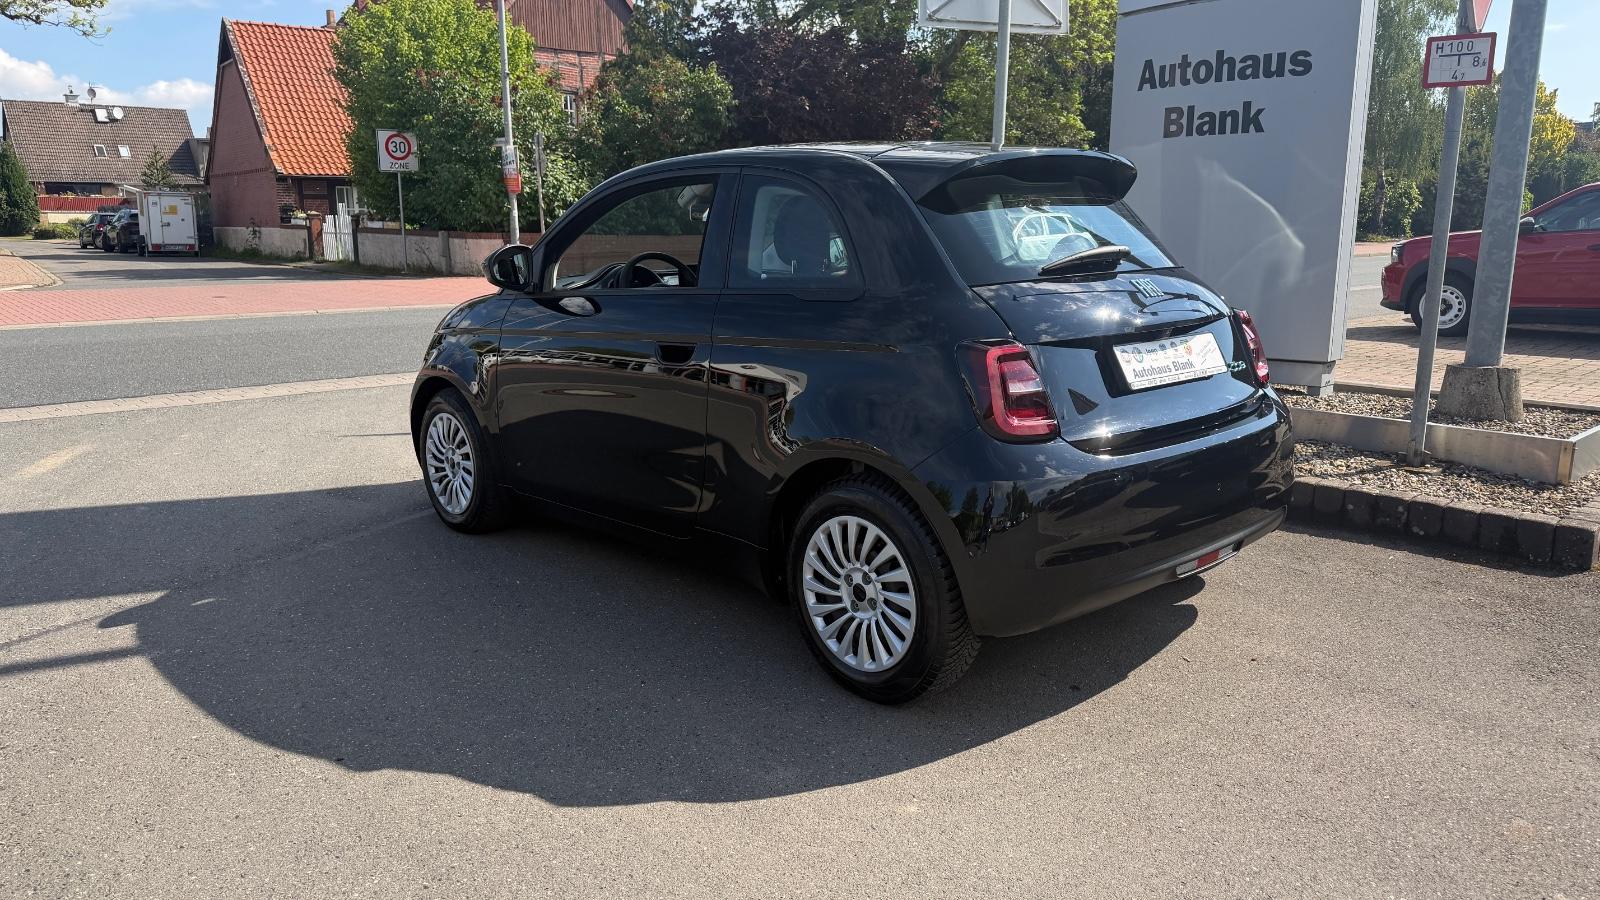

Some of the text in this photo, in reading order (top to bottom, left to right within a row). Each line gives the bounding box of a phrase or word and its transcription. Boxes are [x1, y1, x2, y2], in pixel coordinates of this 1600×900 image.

[1137, 50, 1313, 91] Autohaus
[1163, 101, 1266, 138] Blank
[390, 141, 406, 153] 30
[1133, 364, 1172, 379] Autohaus
[1172, 359, 1195, 371] Blank
